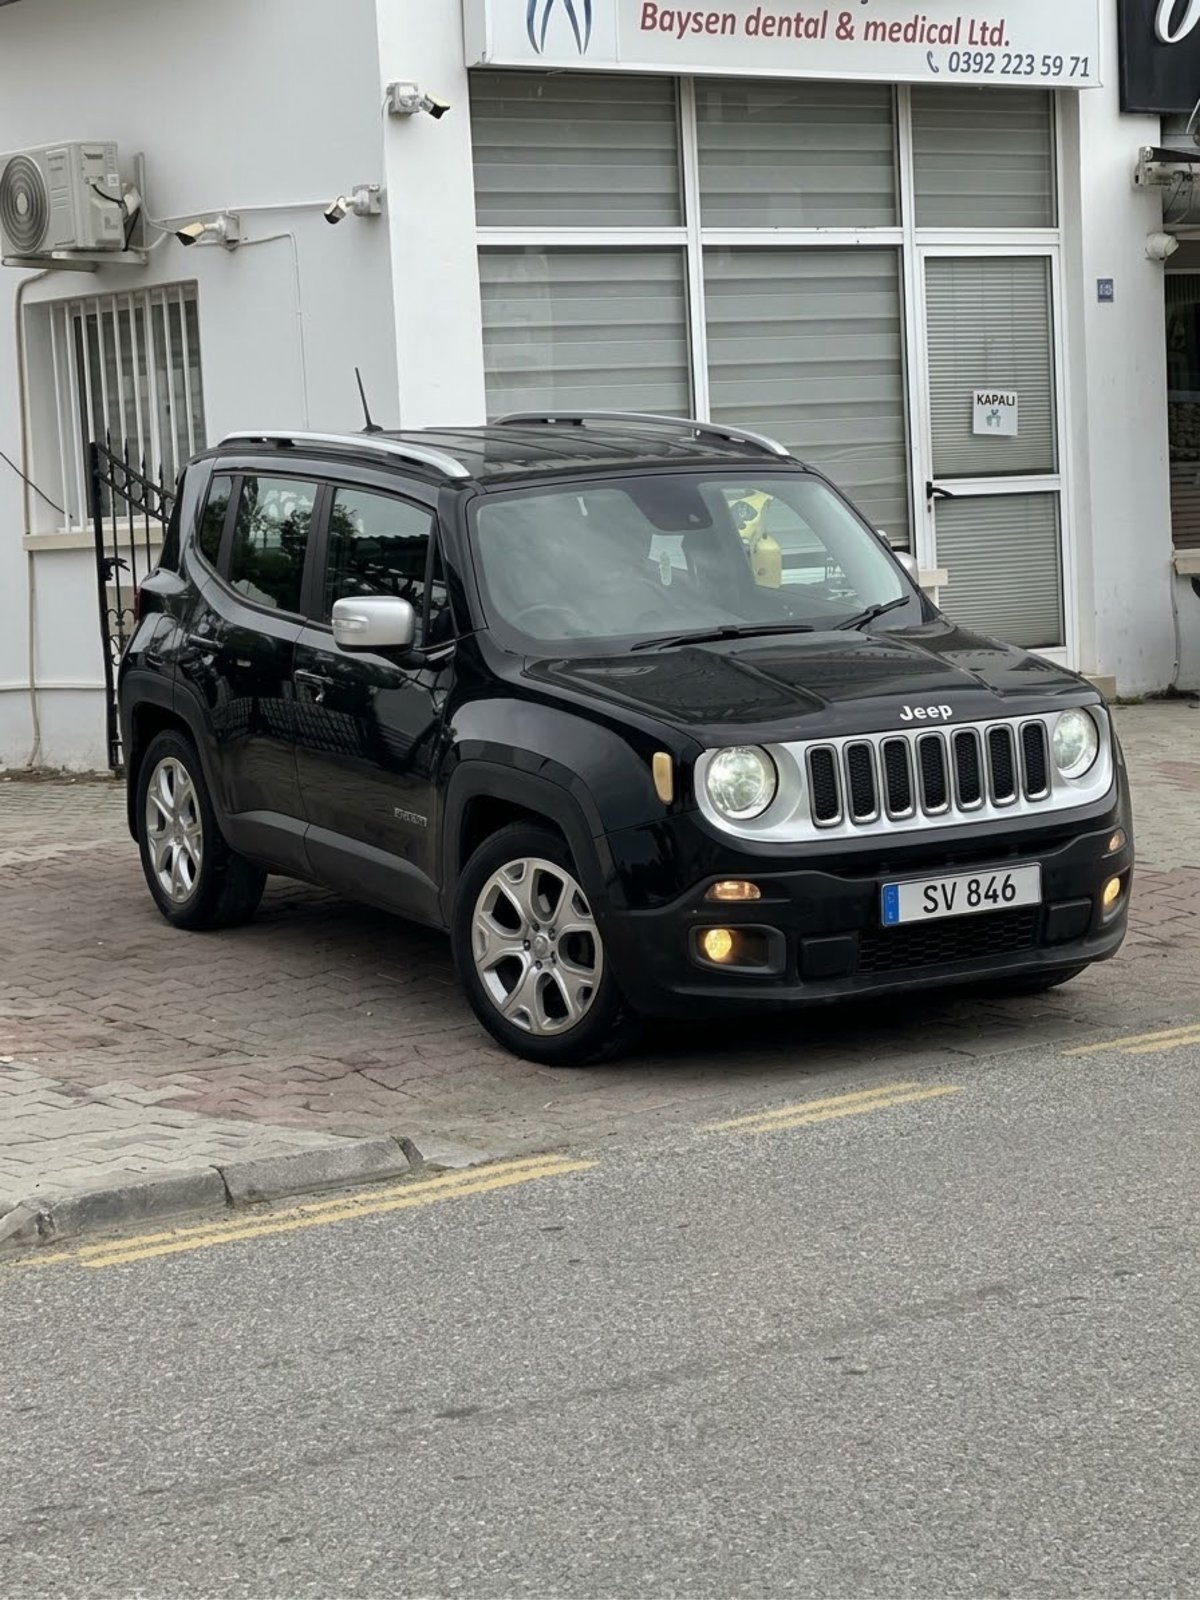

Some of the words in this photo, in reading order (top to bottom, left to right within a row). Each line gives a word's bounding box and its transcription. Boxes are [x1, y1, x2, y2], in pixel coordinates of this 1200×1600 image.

[640, 2, 737, 40] Baysen
[745, 6, 829, 39] dental
[835, 11, 855, 41] &
[863, 14, 961, 45] medical
[967, 19, 1010, 47] Ltd.
[948, 51, 995, 74] 0392
[1000, 53, 1035, 75] 223
[1040, 55, 1063, 76] 59
[1069, 56, 1090, 77] 71
[899, 704, 953, 721] Jeep
[923, 881, 957, 914] SV
[967, 873, 1016, 907] 846
